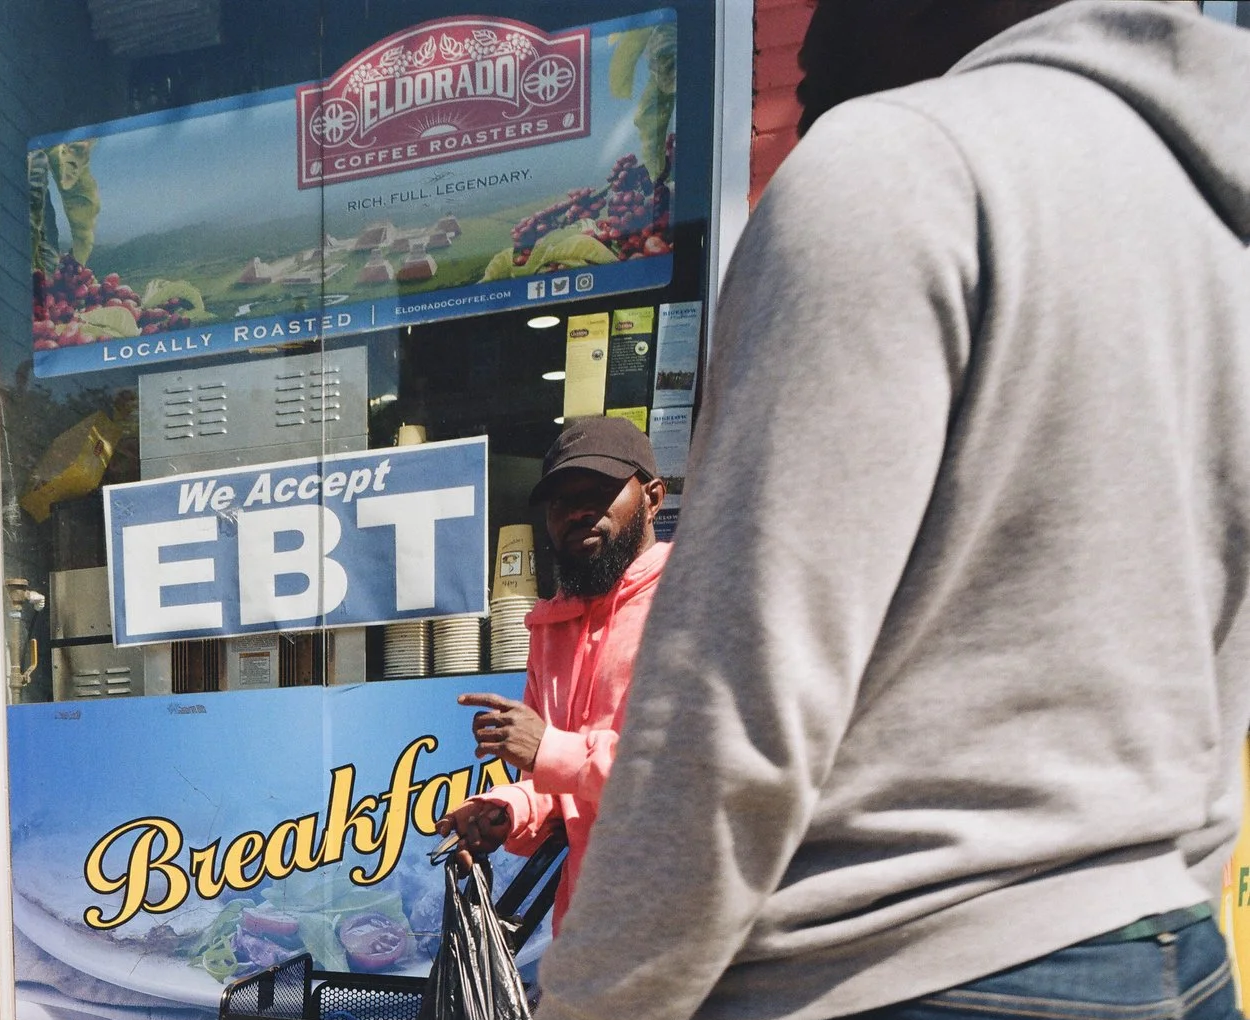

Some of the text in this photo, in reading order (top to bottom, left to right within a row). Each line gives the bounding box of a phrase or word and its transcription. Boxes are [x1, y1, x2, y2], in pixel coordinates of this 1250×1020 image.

[364, 55, 515, 129] ELDORADO
[333, 119, 550, 171] COFFEE ROASTERS
[347, 168, 533, 212] RICH. FULL. LEGENDARY.
[103, 313, 352, 362] LOCALLY ROASTED
[177, 458, 392, 515] We Accept
[122, 485, 475, 636] EBT
